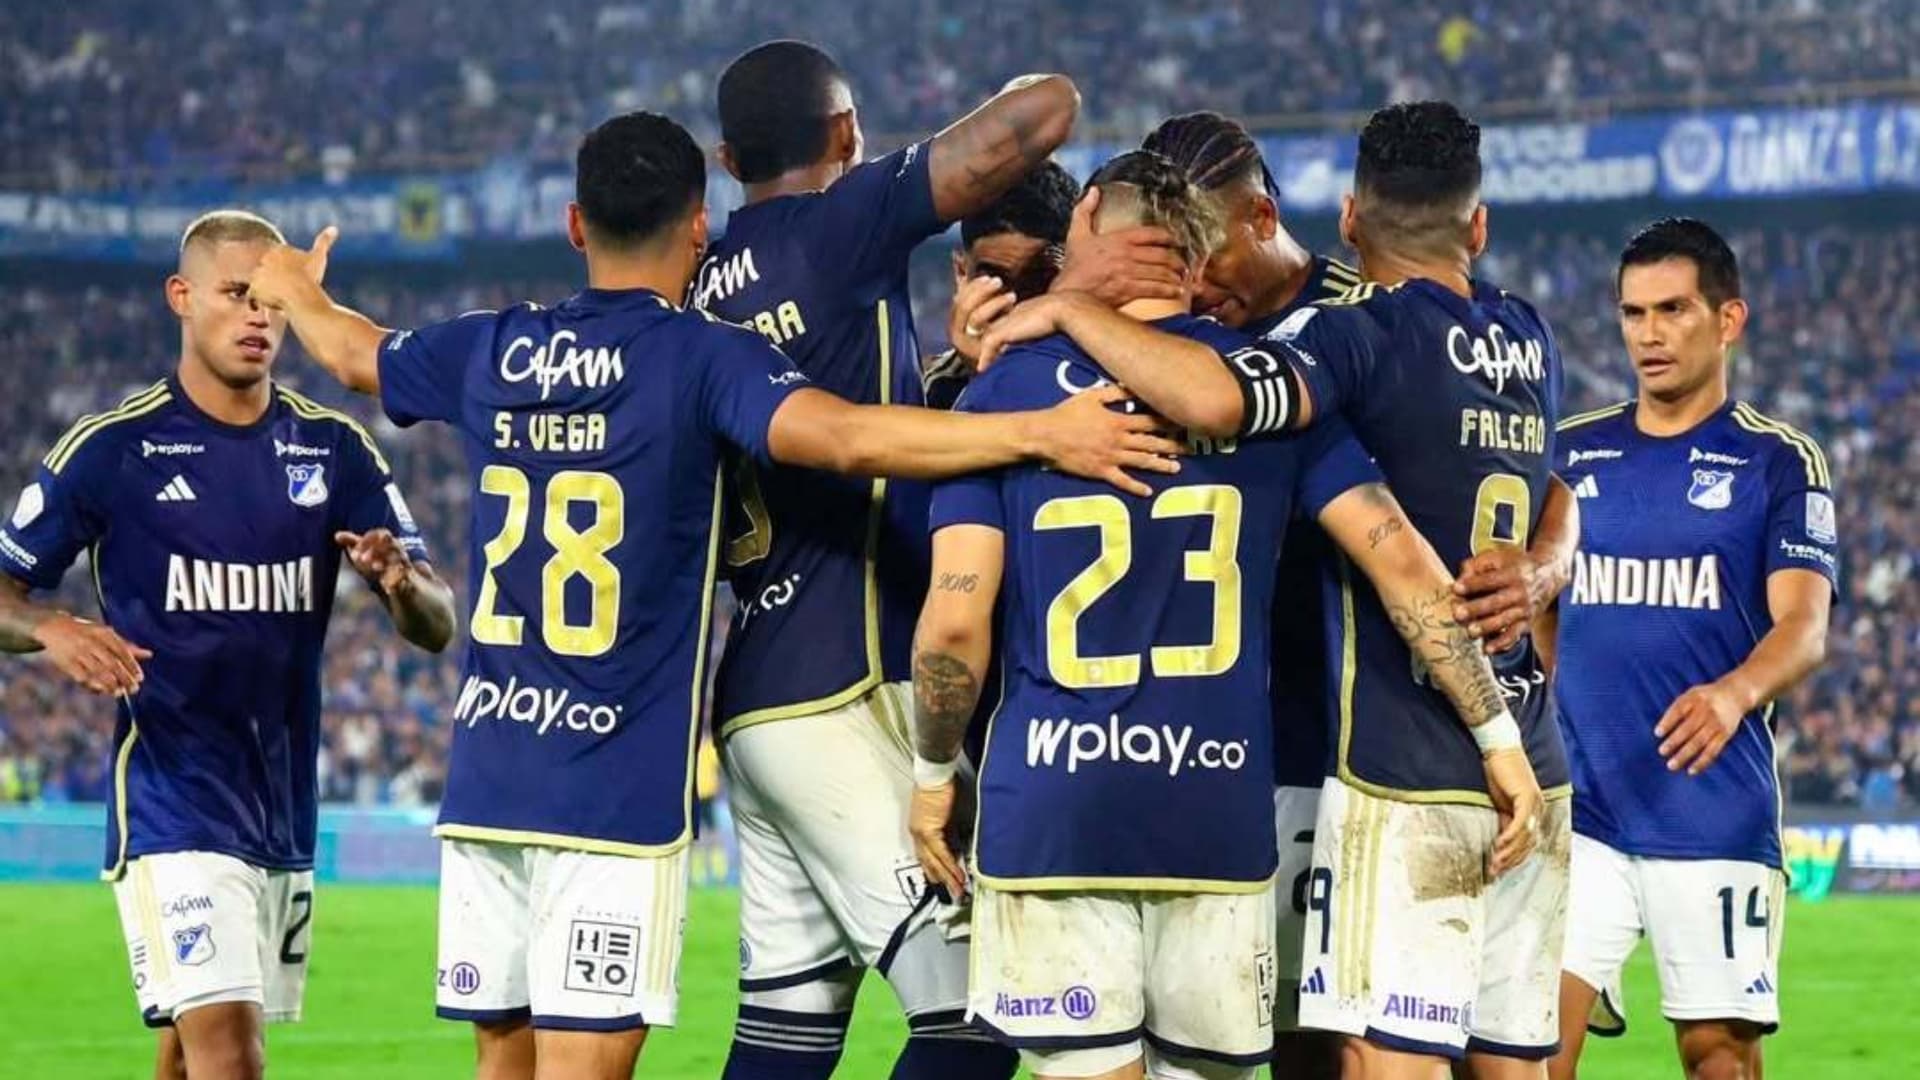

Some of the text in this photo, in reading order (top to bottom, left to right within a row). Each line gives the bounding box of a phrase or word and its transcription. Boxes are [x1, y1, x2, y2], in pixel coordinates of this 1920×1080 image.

[494, 411, 607, 452] S. VEGA
[1459, 407, 1545, 454] FALCAO
[165, 554, 314, 612] ANDINA
[471, 464, 625, 657] 28
[1033, 484, 1243, 688] 23
[1570, 549, 1721, 610] ANDINA
[1309, 866, 1332, 955] 9
[1717, 884, 1770, 959] 14
[1382, 993, 1460, 1026] Allianz
